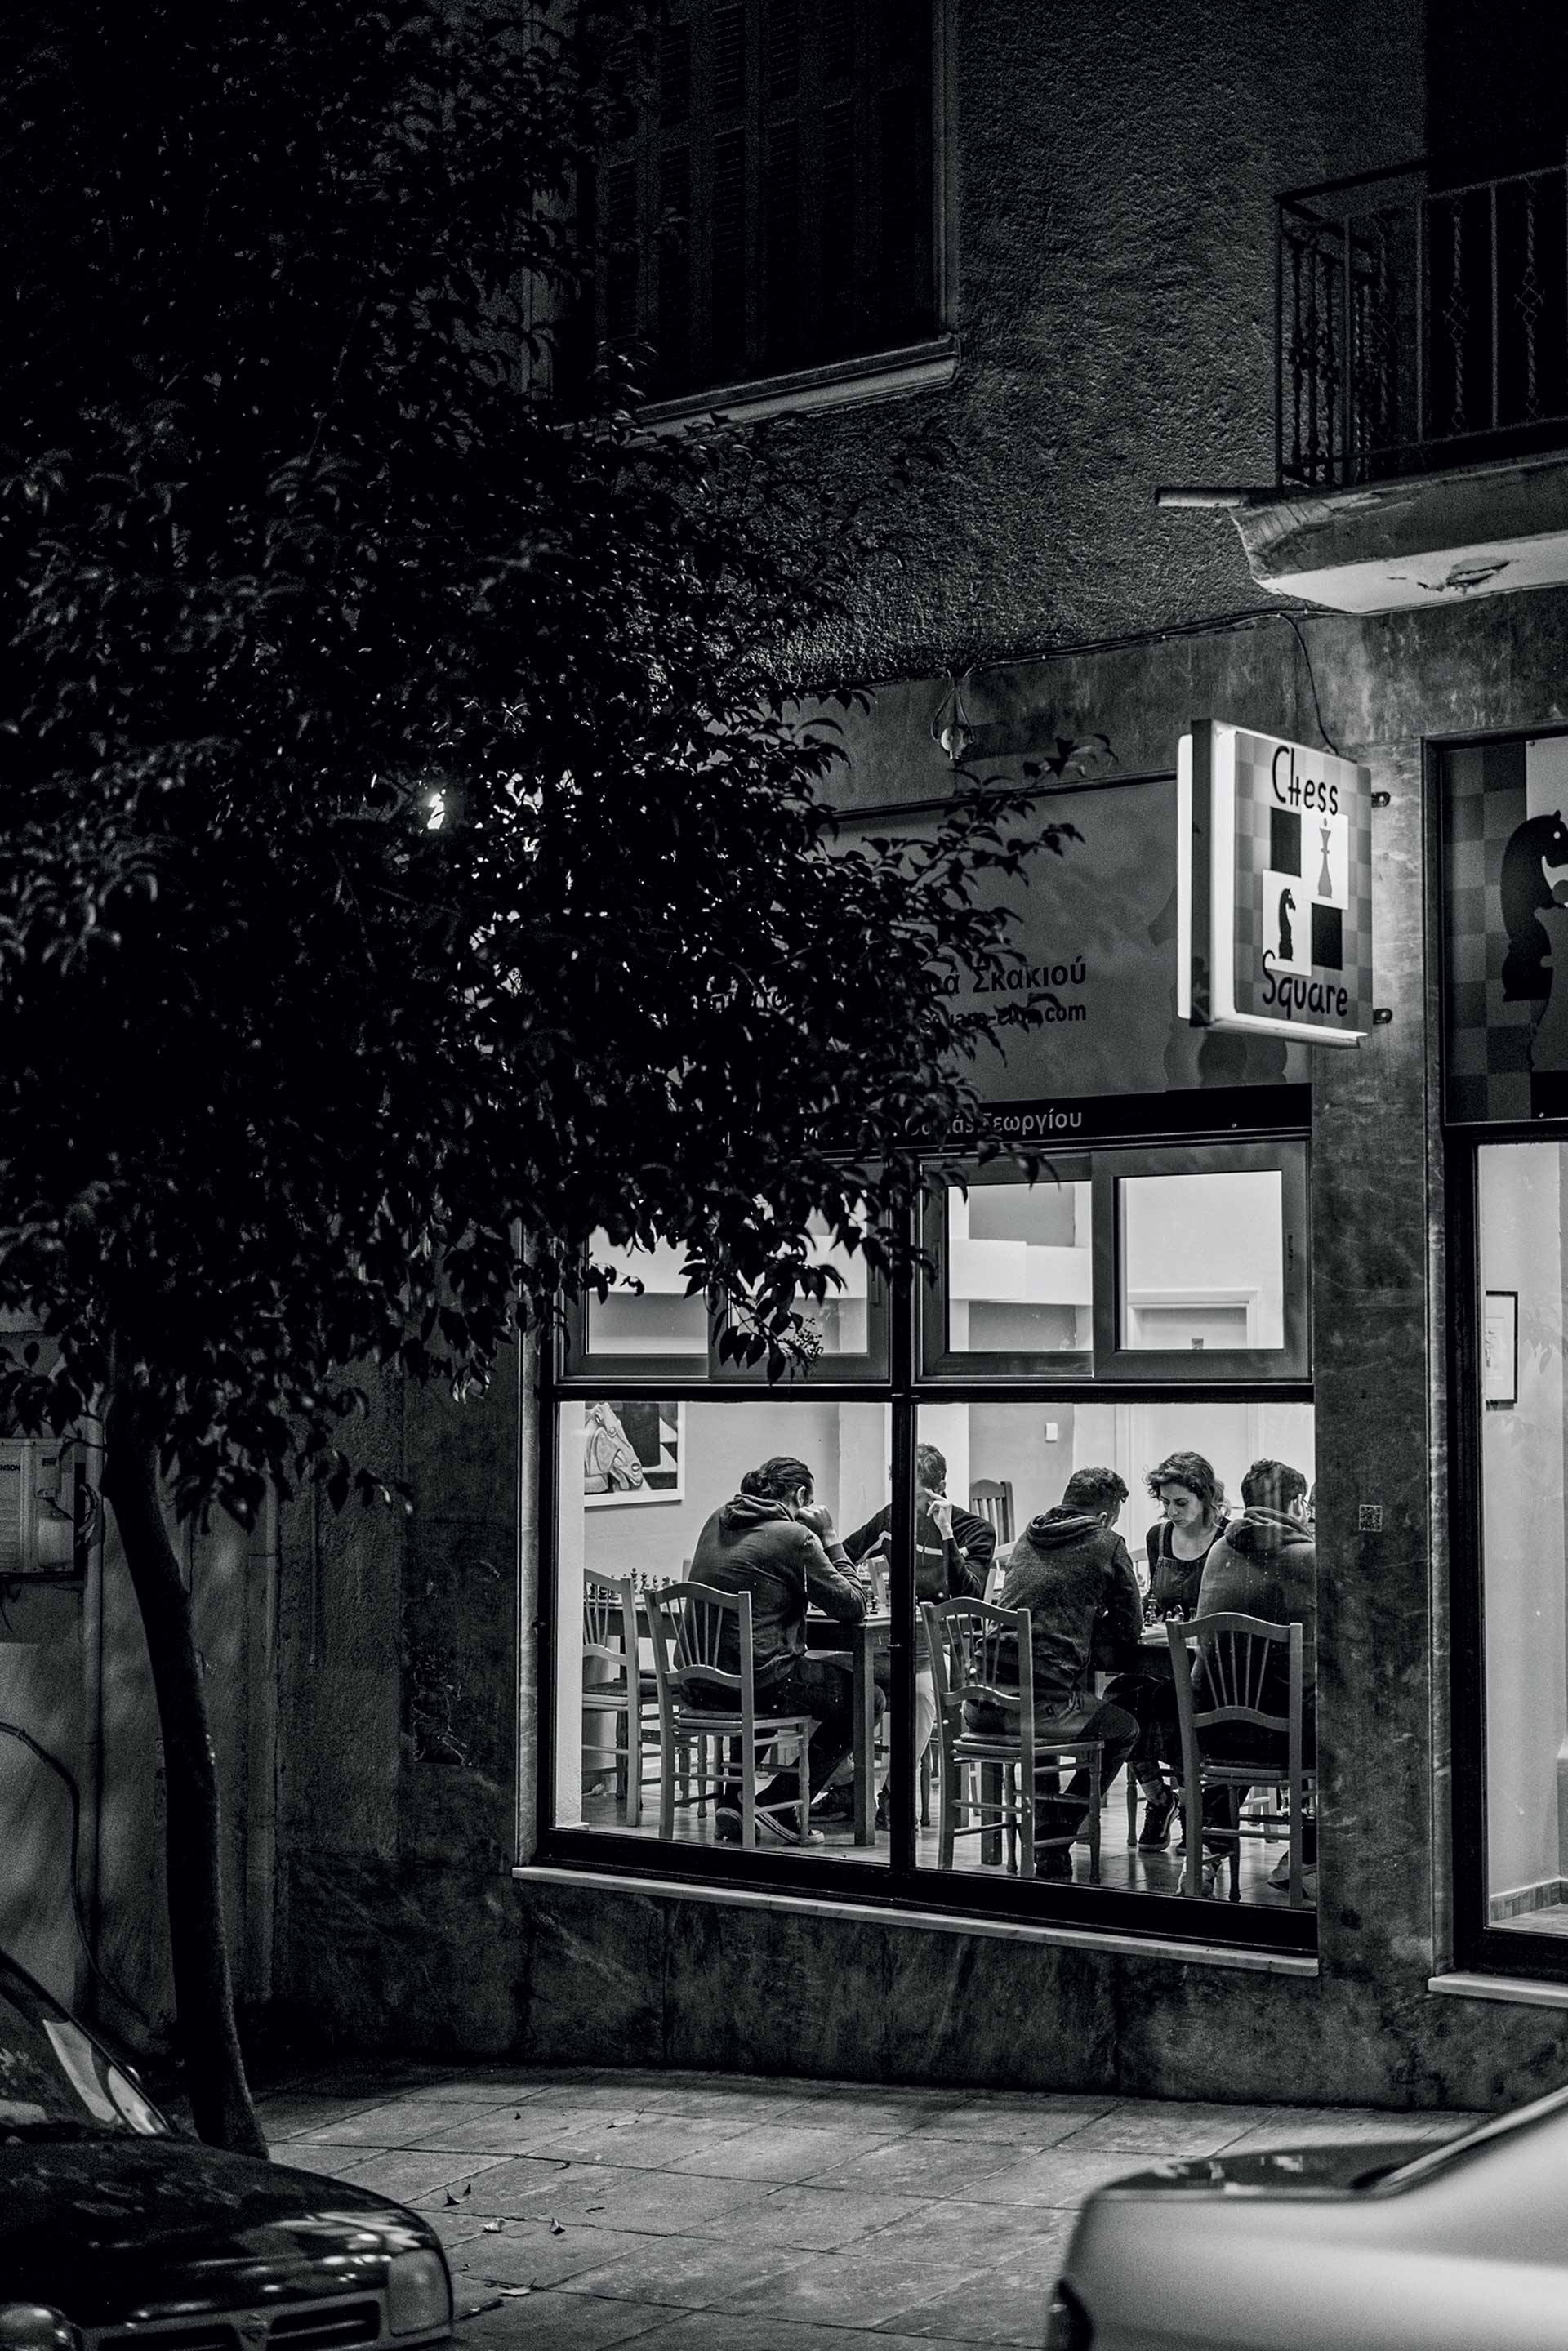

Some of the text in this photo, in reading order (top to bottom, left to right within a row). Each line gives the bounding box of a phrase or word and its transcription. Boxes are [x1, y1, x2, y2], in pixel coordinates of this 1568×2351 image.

[1272, 745, 1339, 816] Chess
[972, 955, 1087, 994] Σκακιού
[1262, 949, 1348, 1020] Square
